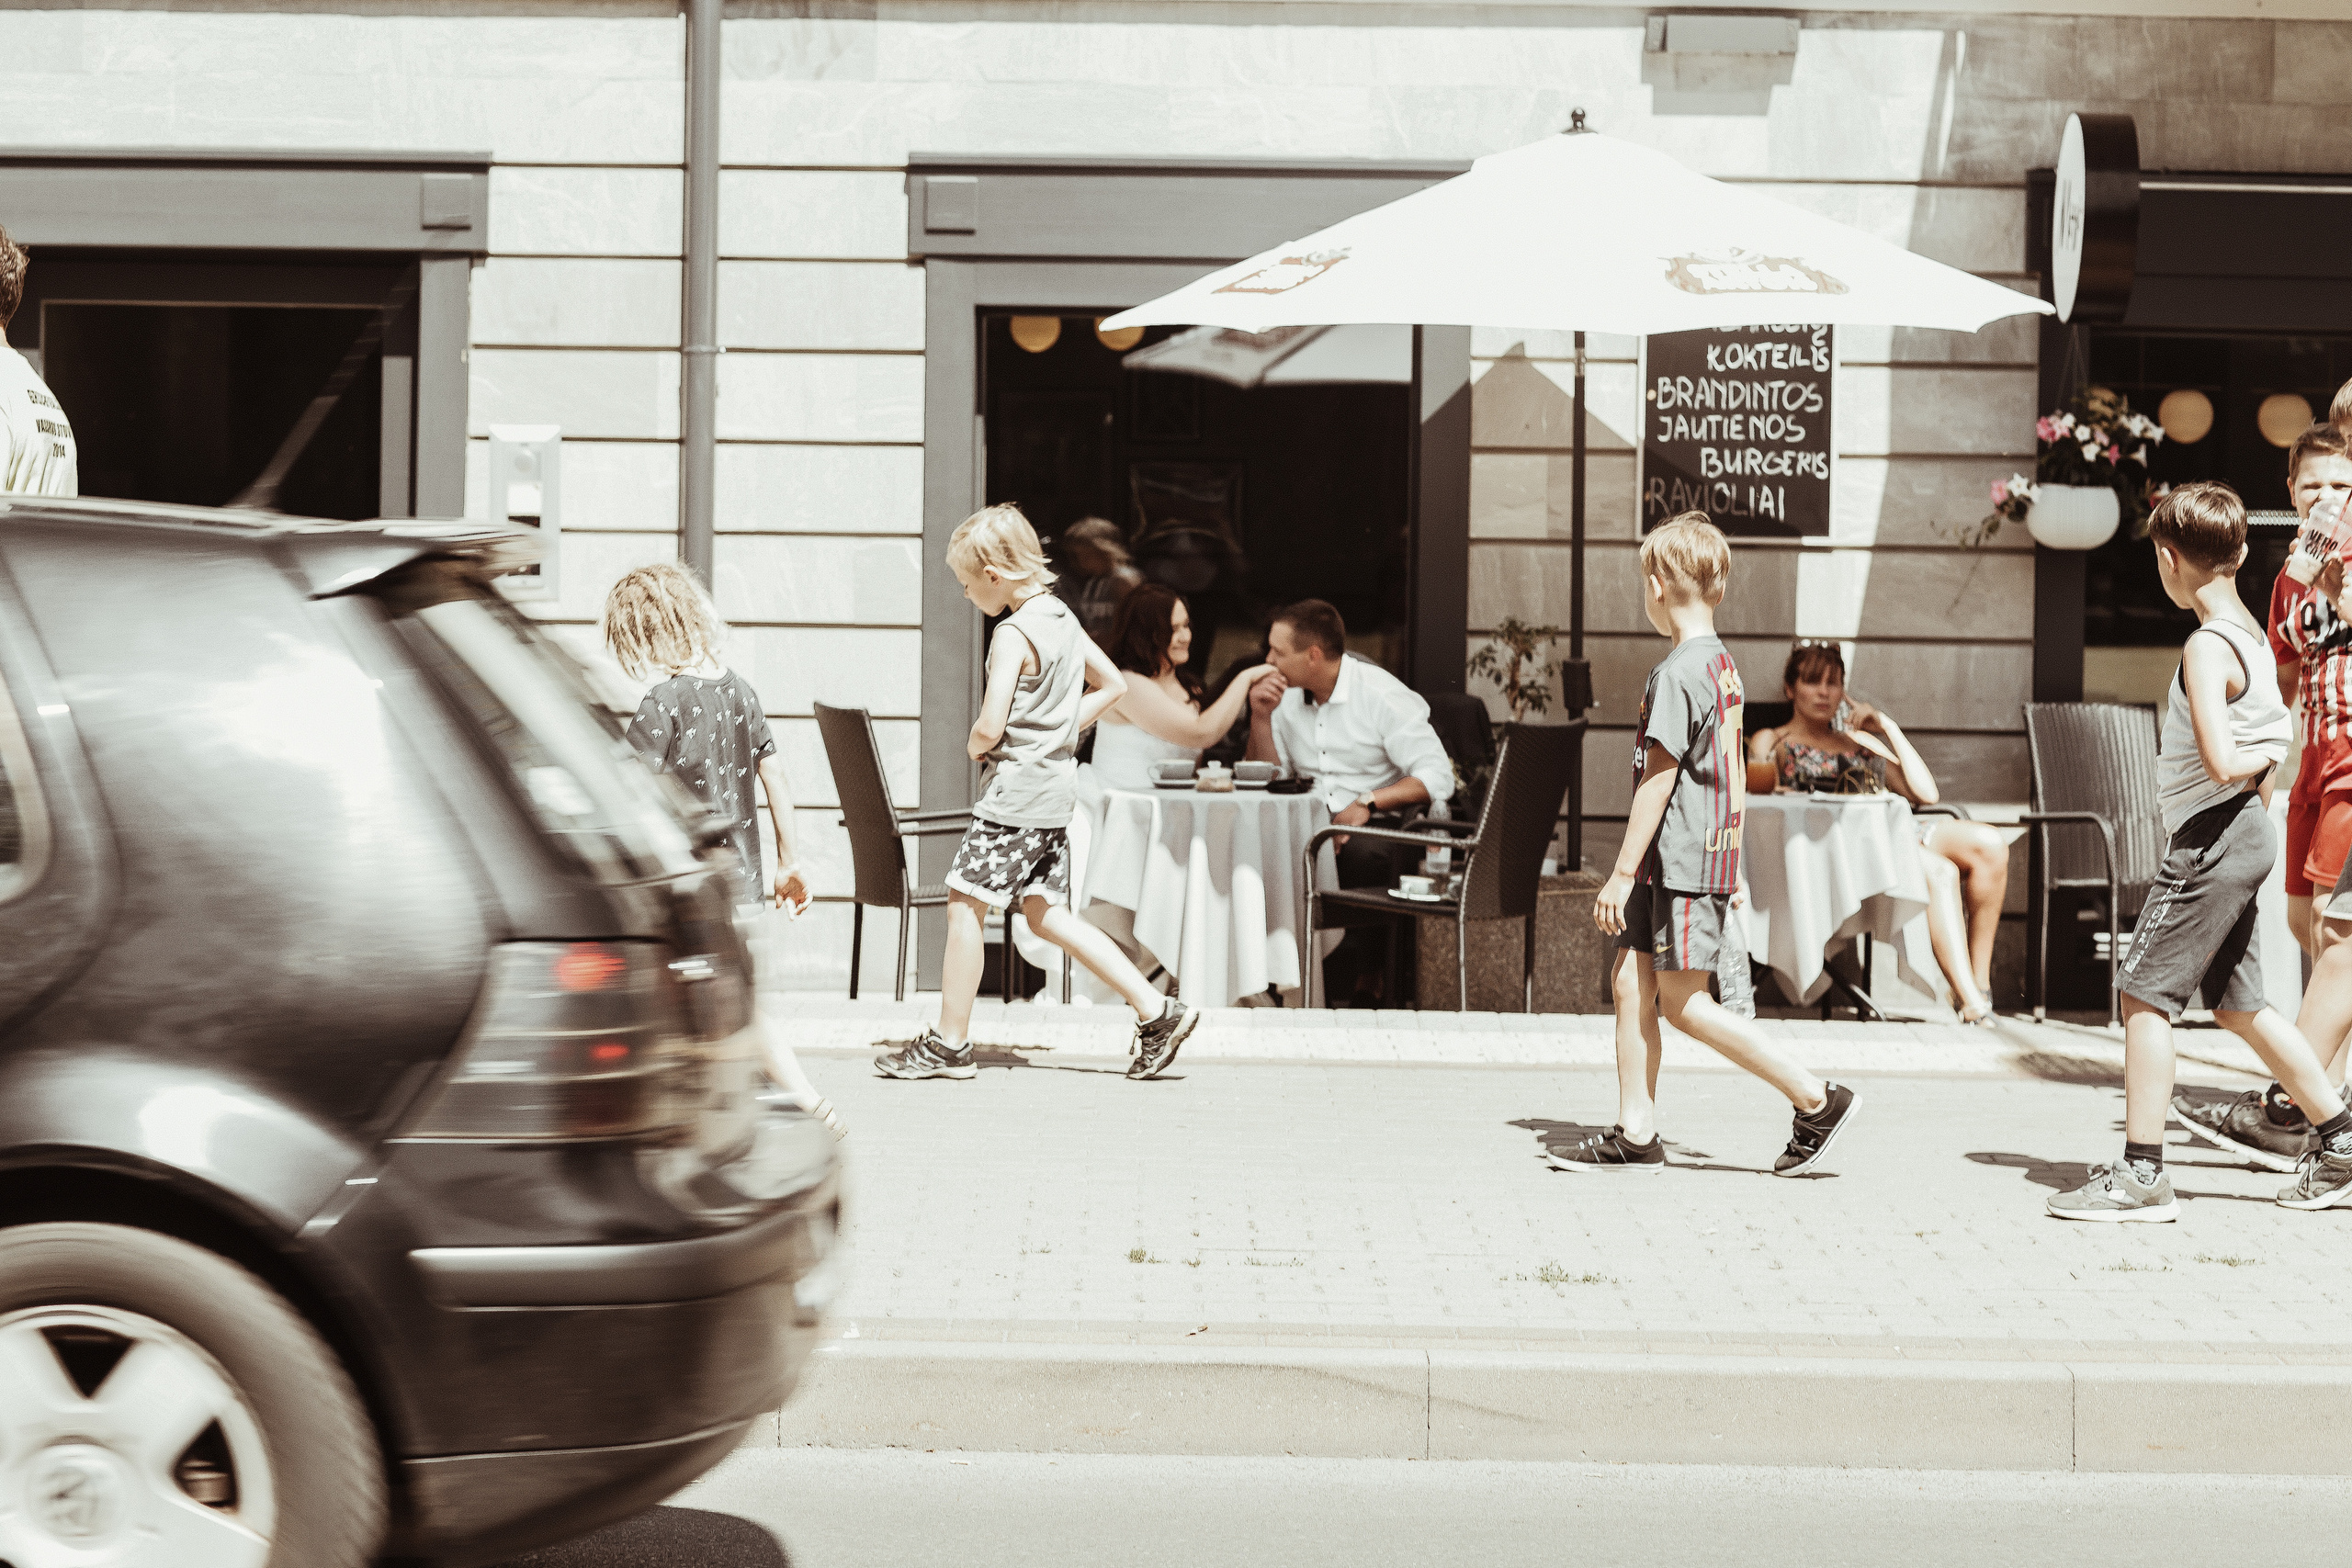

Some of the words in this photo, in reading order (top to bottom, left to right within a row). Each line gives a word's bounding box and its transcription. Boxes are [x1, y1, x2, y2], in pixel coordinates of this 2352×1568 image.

[1657, 376, 1824, 412] BRANDINTOS
[1657, 414, 1806, 443] JAUTIENOS
[1701, 446, 1829, 480] BURGERIS
[1648, 476, 1785, 523] RAVIOLIAI
